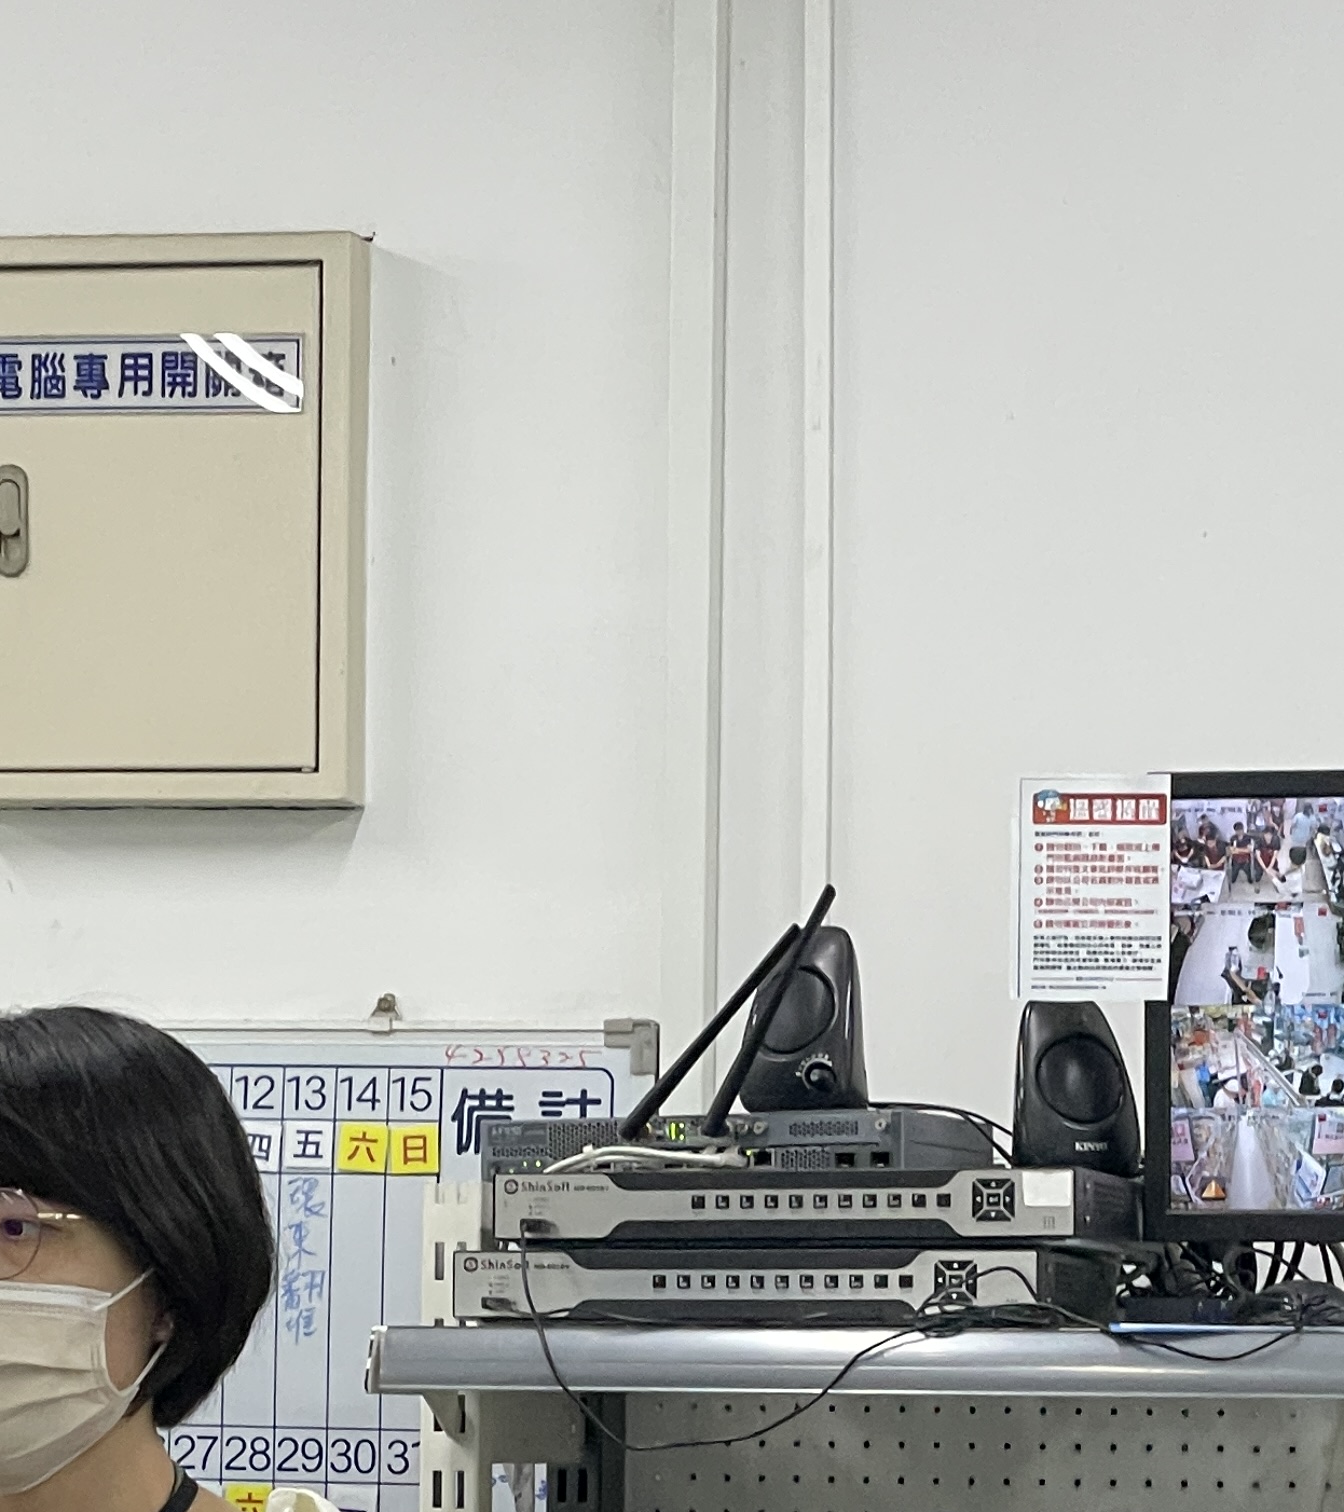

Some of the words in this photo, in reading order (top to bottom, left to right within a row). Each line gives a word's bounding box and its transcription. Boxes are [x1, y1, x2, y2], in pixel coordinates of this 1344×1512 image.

[235, 1077, 275, 1111] 12
[287, 1076, 327, 1111] 13
[340, 1076, 381, 1112] 14
[392, 1077, 433, 1112] 15
[292, 1129, 324, 1160] 五
[346, 1130, 380, 1164] 六
[400, 1133, 429, 1166] 日
[174, 1435, 219, 1470] 27
[225, 1435, 271, 1472] 28
[277, 1437, 324, 1473] 29
[330, 1438, 377, 1474] 30
[387, 1439, 420, 1475] 3
